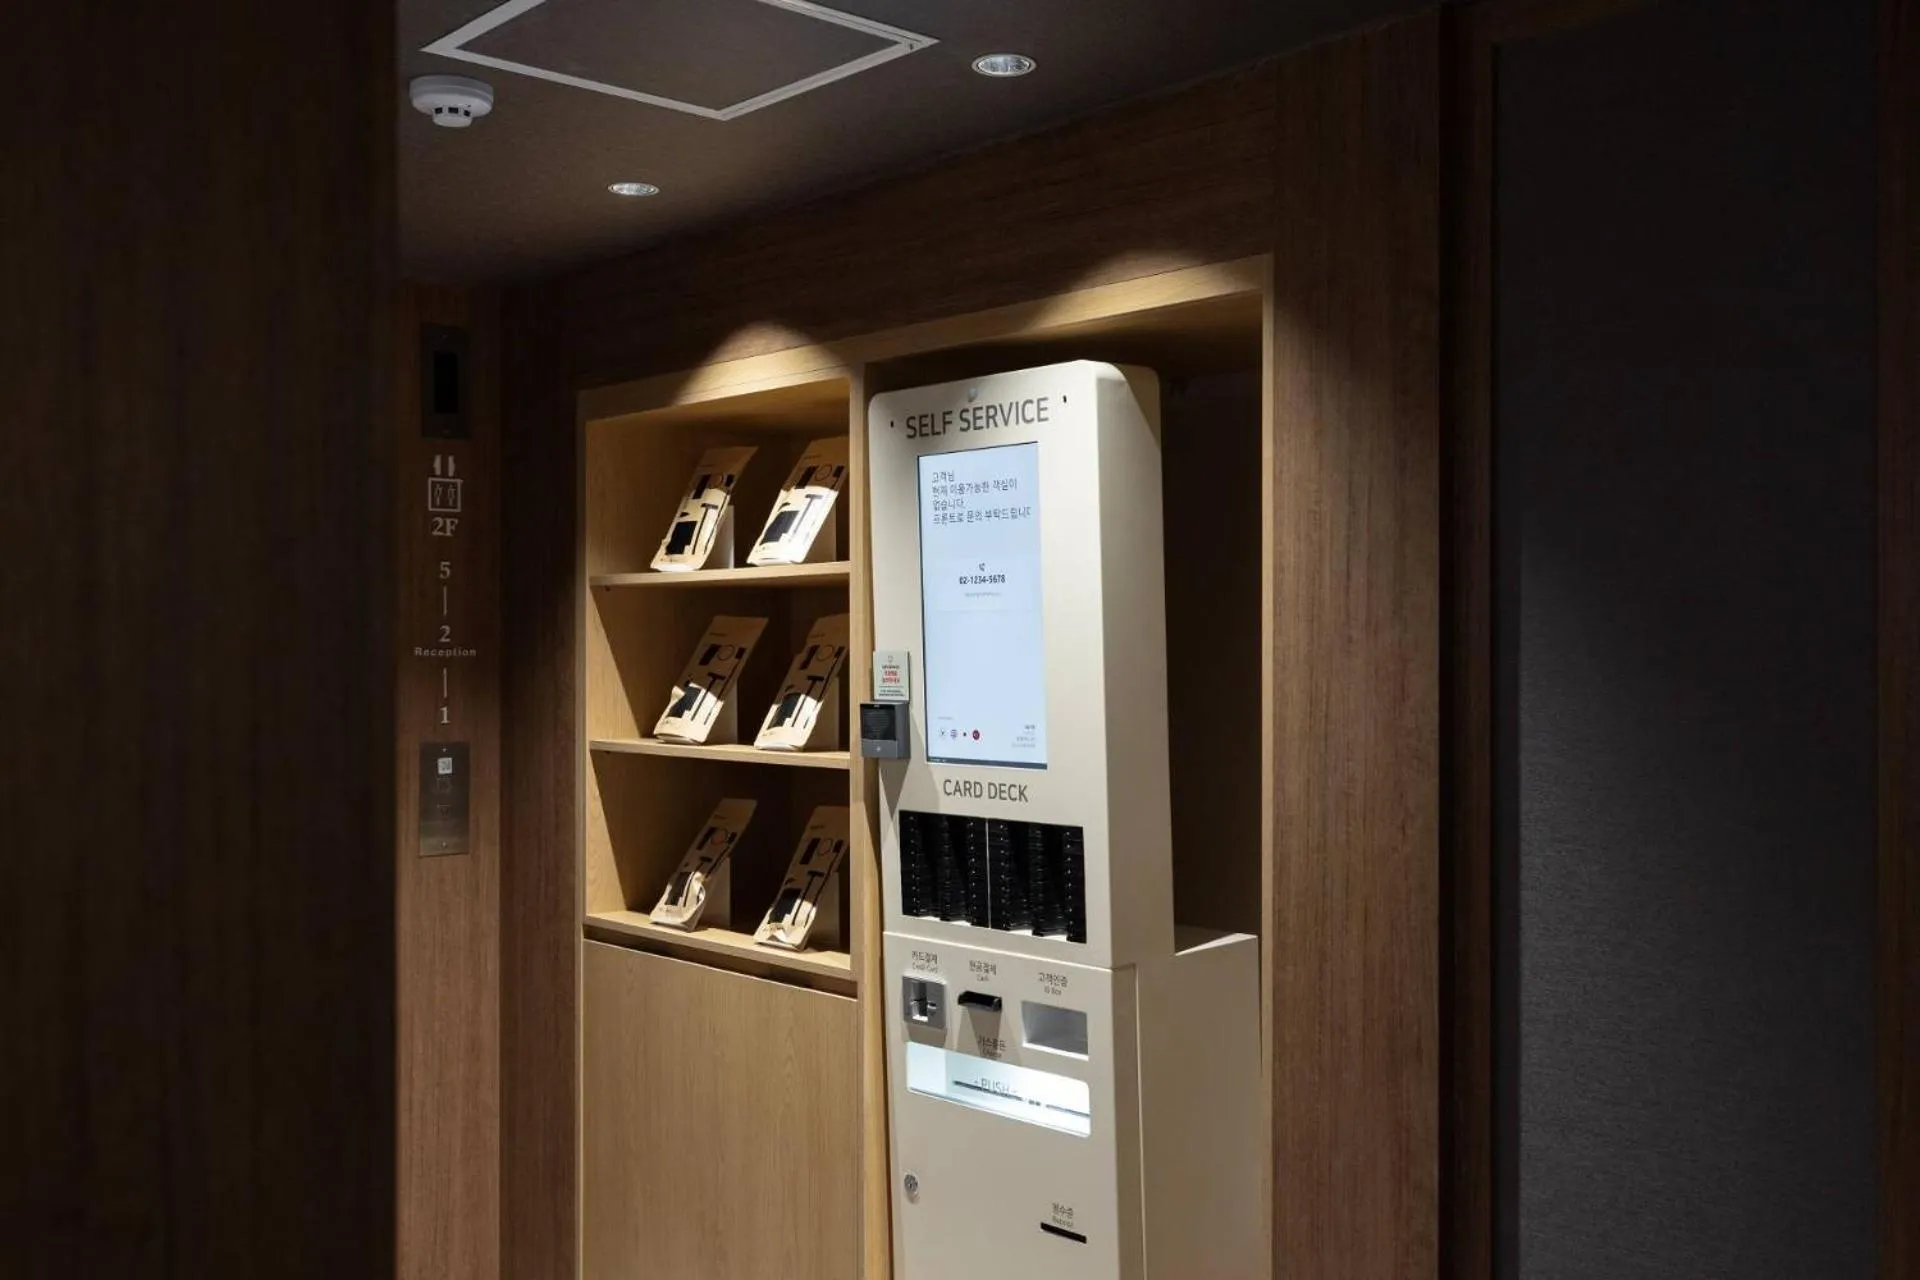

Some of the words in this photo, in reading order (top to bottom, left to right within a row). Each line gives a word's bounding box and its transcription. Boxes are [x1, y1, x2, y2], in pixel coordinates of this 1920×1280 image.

[906, 410, 953, 440] SELF
[959, 397, 1050, 432] SERVICE
[949, 480, 990, 495] 이용가능한
[431, 517, 459, 537] 2F
[438, 561, 452, 579] 5
[959, 574, 1006, 585] 02-1234-5678
[438, 625, 452, 643] 2
[414, 647, 477, 659] Reception
[439, 706, 451, 724] 1
[943, 778, 983, 799] CARD
[988, 782, 1029, 803] DECK
